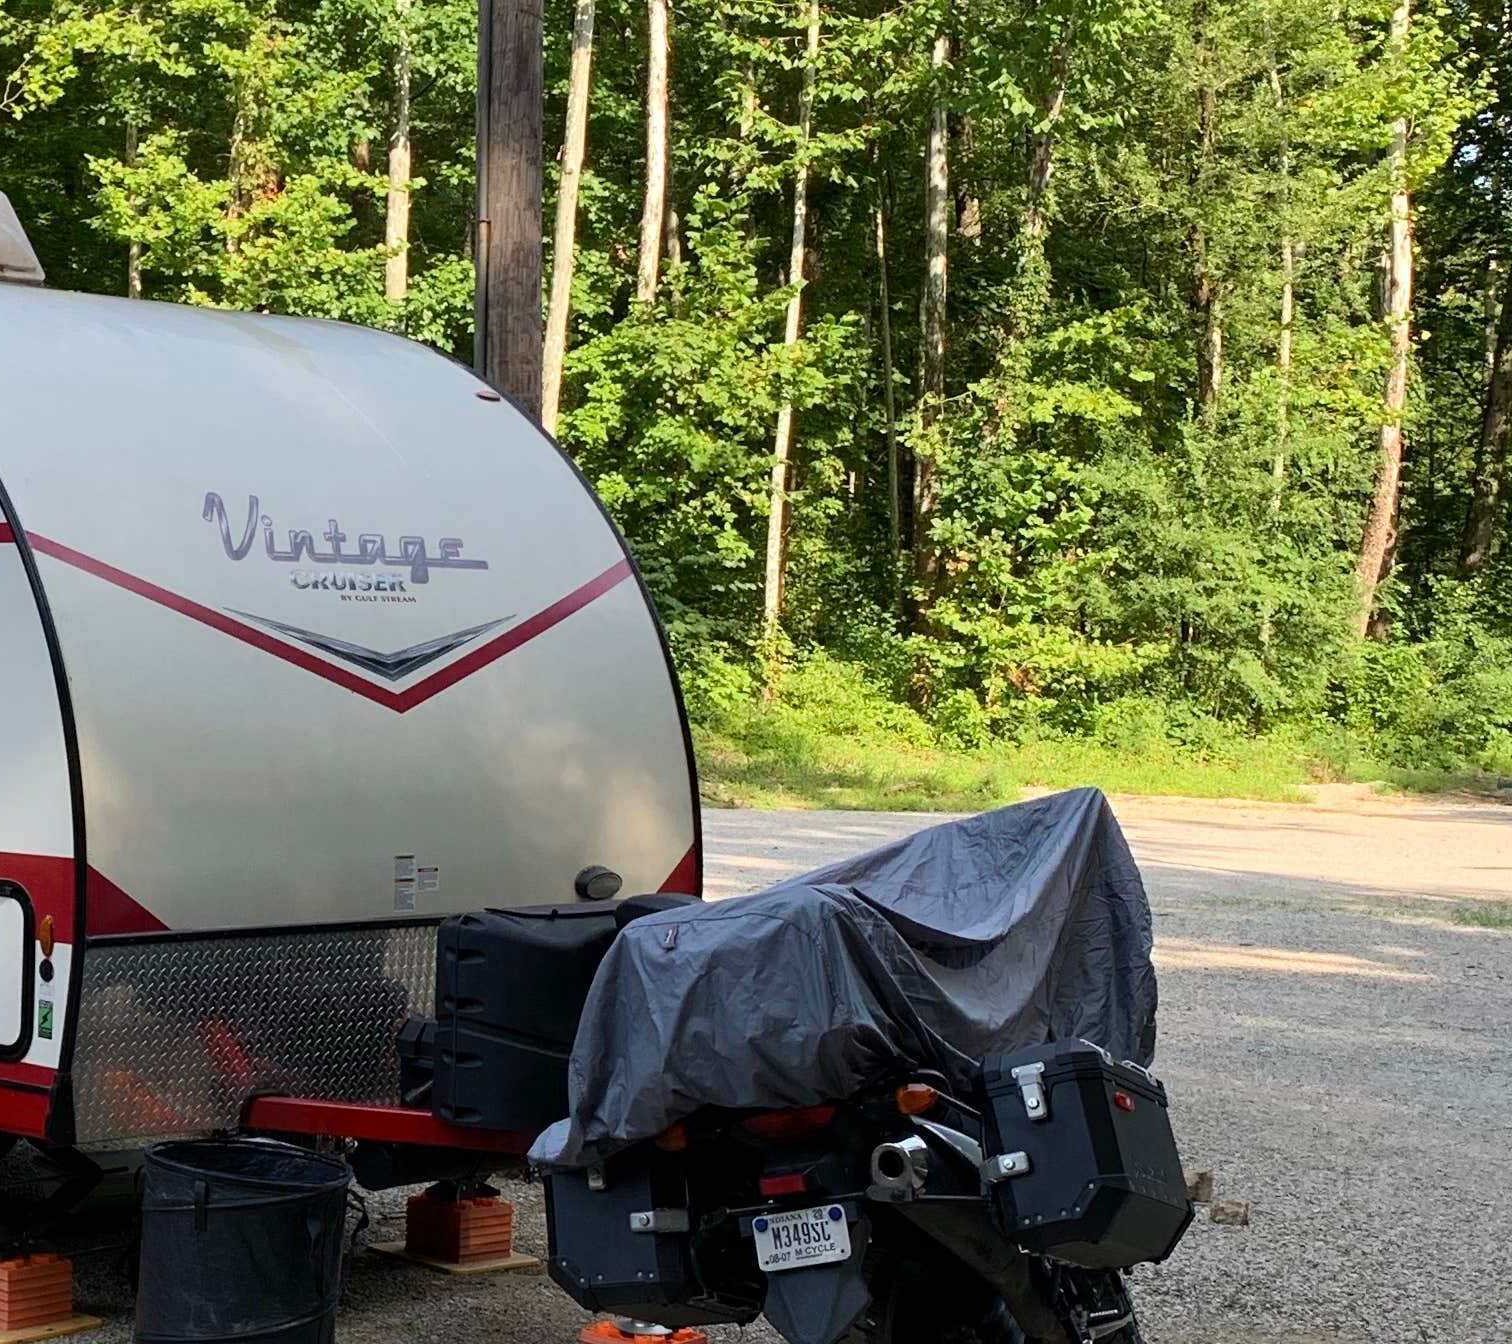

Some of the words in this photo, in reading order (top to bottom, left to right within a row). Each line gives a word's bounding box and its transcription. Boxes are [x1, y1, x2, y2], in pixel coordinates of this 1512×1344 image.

[202, 491, 488, 584] Vintage
[289, 569, 407, 592] CRUISER
[768, 1212, 803, 1225] NDIANA
[804, 1242, 836, 1255] CYCLE
